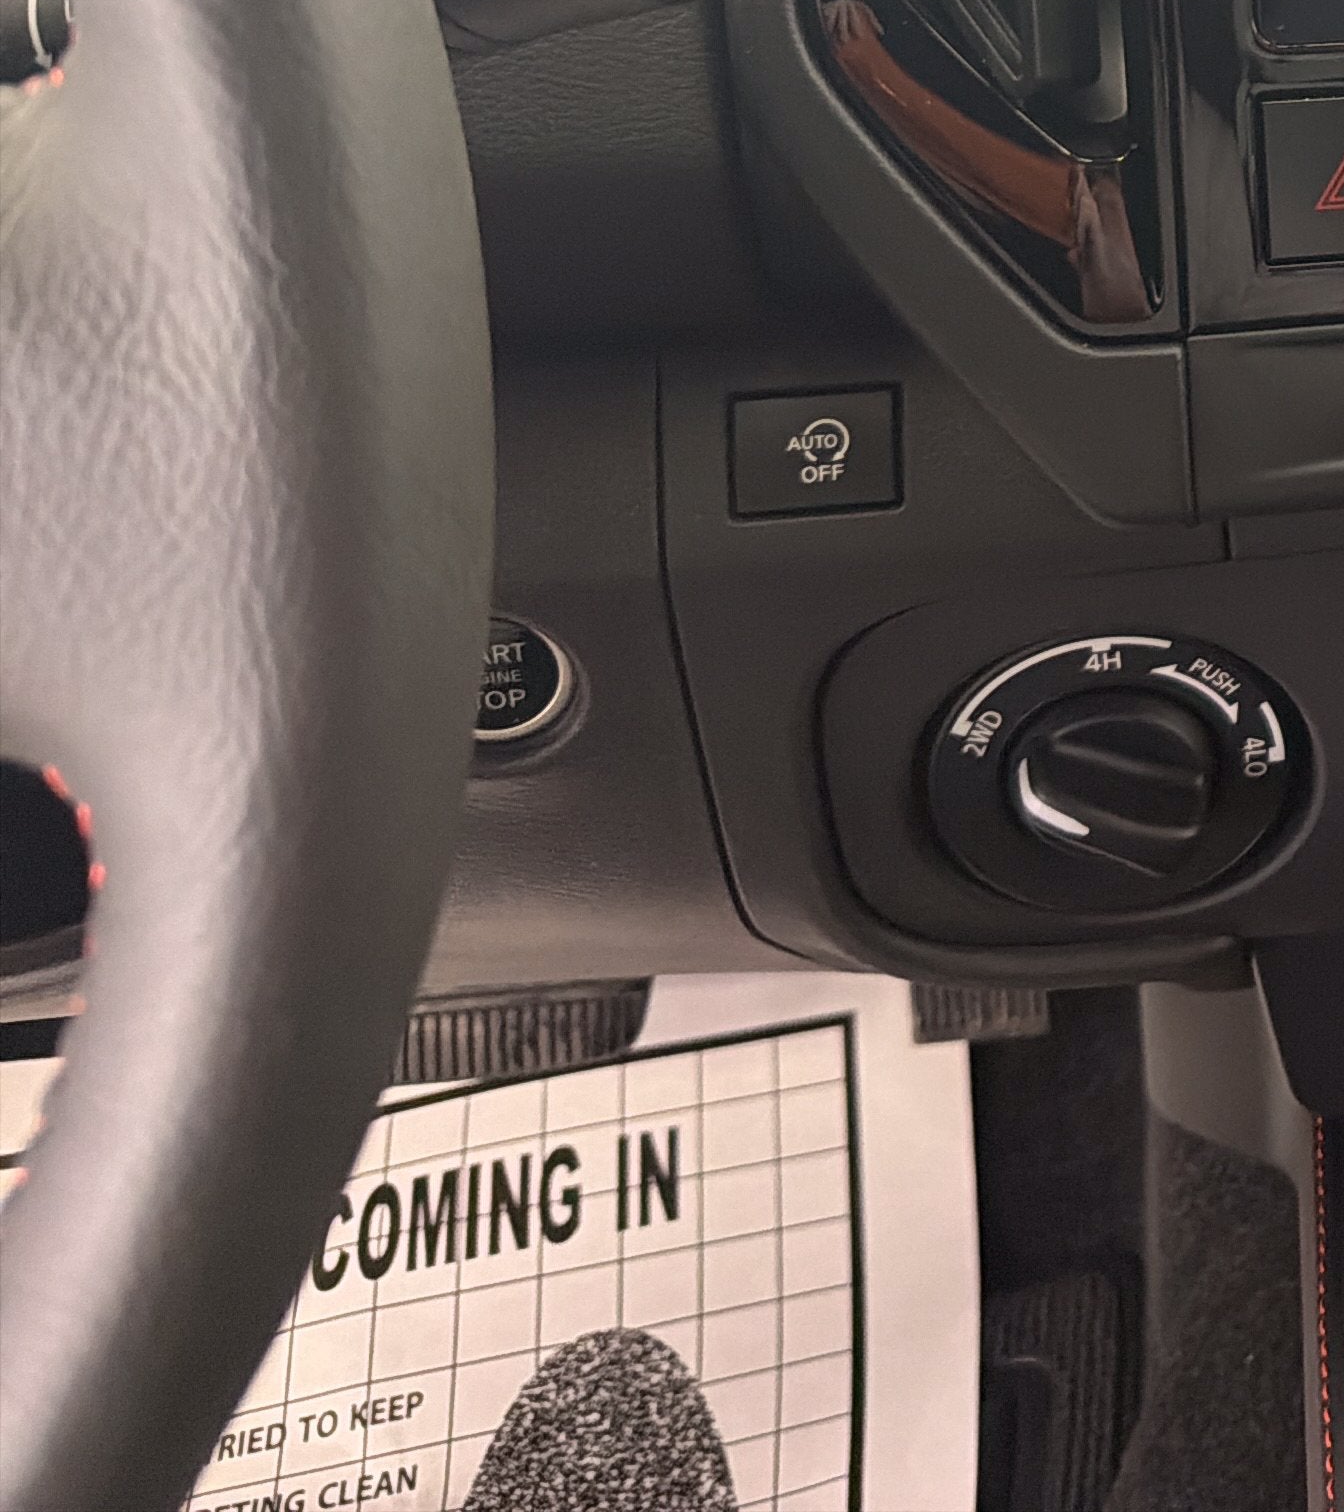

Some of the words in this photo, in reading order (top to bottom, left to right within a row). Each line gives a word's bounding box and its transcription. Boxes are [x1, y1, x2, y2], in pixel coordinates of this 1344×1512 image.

[786, 433, 838, 453] AUTO
[801, 463, 846, 484] OFF
[1083, 651, 1123, 673] 4H
[1188, 657, 1242, 696] PUSH
[961, 709, 1003, 758] 2WD
[1241, 736, 1268, 778] 4LO
[616, 1124, 682, 1232] IN
[217, 1422, 287, 1462] RIED
[298, 1410, 338, 1443] TO
[349, 1391, 424, 1432] KEEP
[318, 1463, 419, 1510] CLEAN
